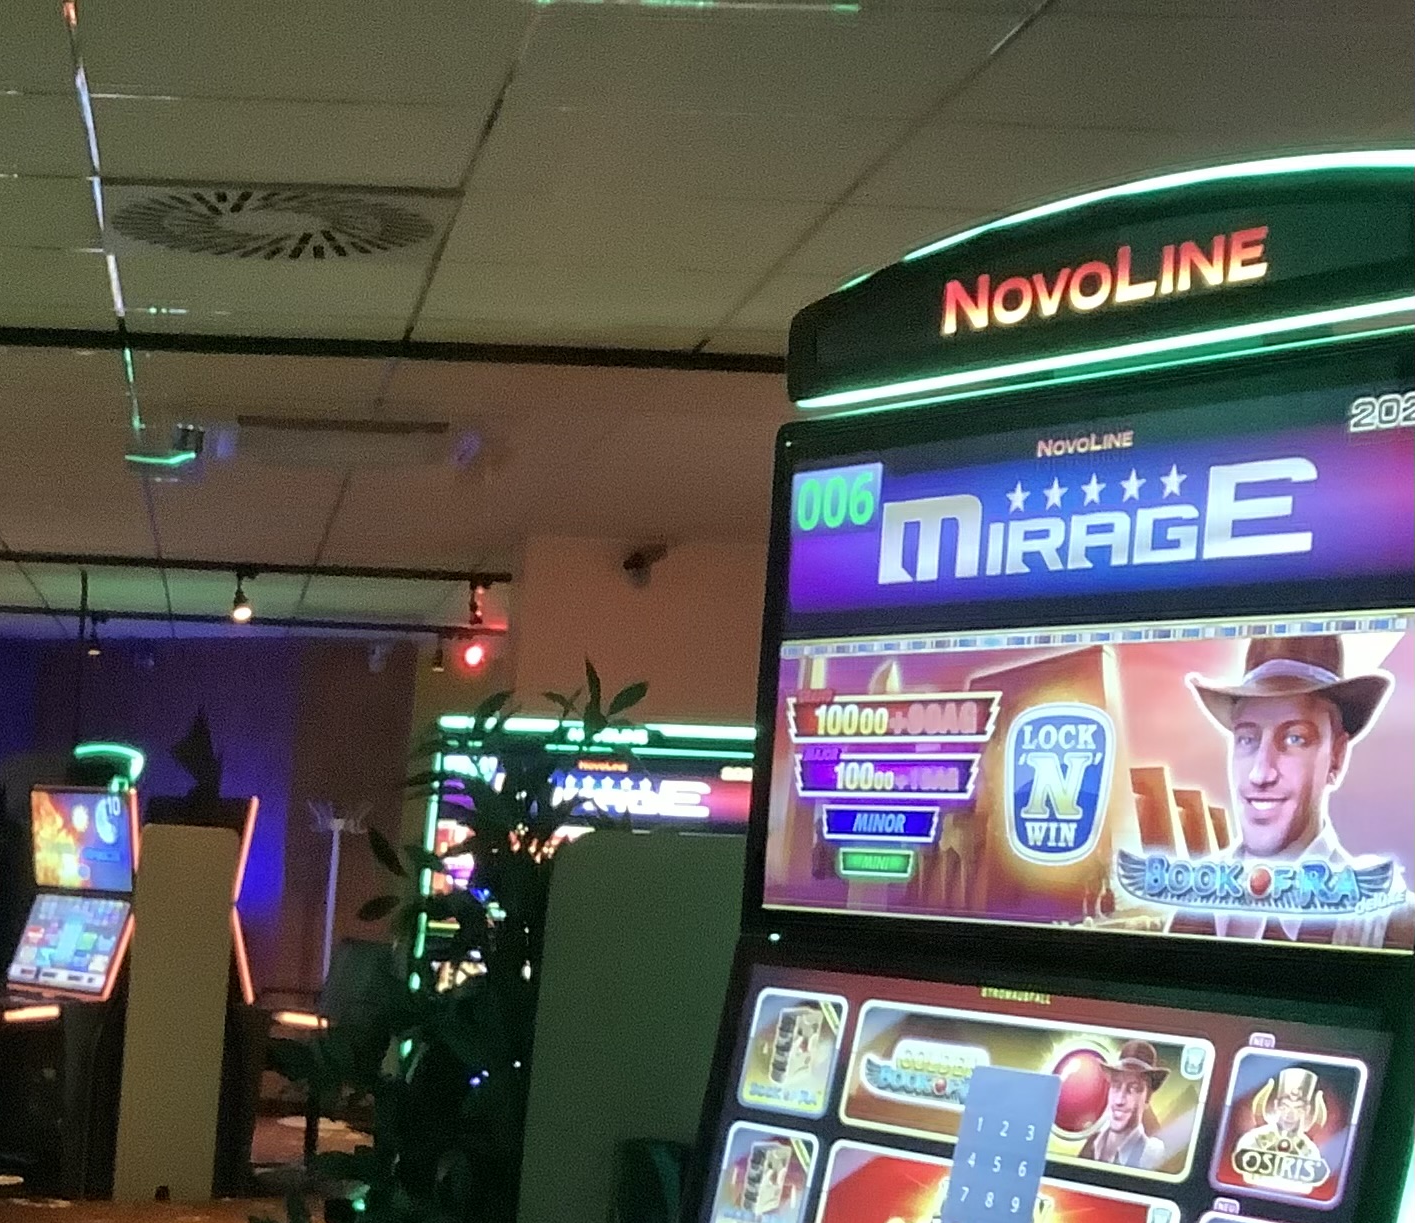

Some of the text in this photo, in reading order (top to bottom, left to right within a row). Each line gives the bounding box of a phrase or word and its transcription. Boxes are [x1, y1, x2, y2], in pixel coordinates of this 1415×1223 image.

[940, 226, 1270, 337] NOVOLINE
[796, 470, 875, 532] 006
[878, 456, 1318, 586] MIRAGE
[1021, 723, 1098, 750] LOCK
[852, 813, 907, 834] MINOR
[1025, 821, 1078, 848] WIN
[1144, 853, 1244, 898] BOOK
[1299, 859, 1362, 909] RA
[977, 1117, 1035, 1142] 1 2 3
[967, 1152, 1028, 1177] 4 5 6
[960, 1186, 1020, 1213] 7 8 9
